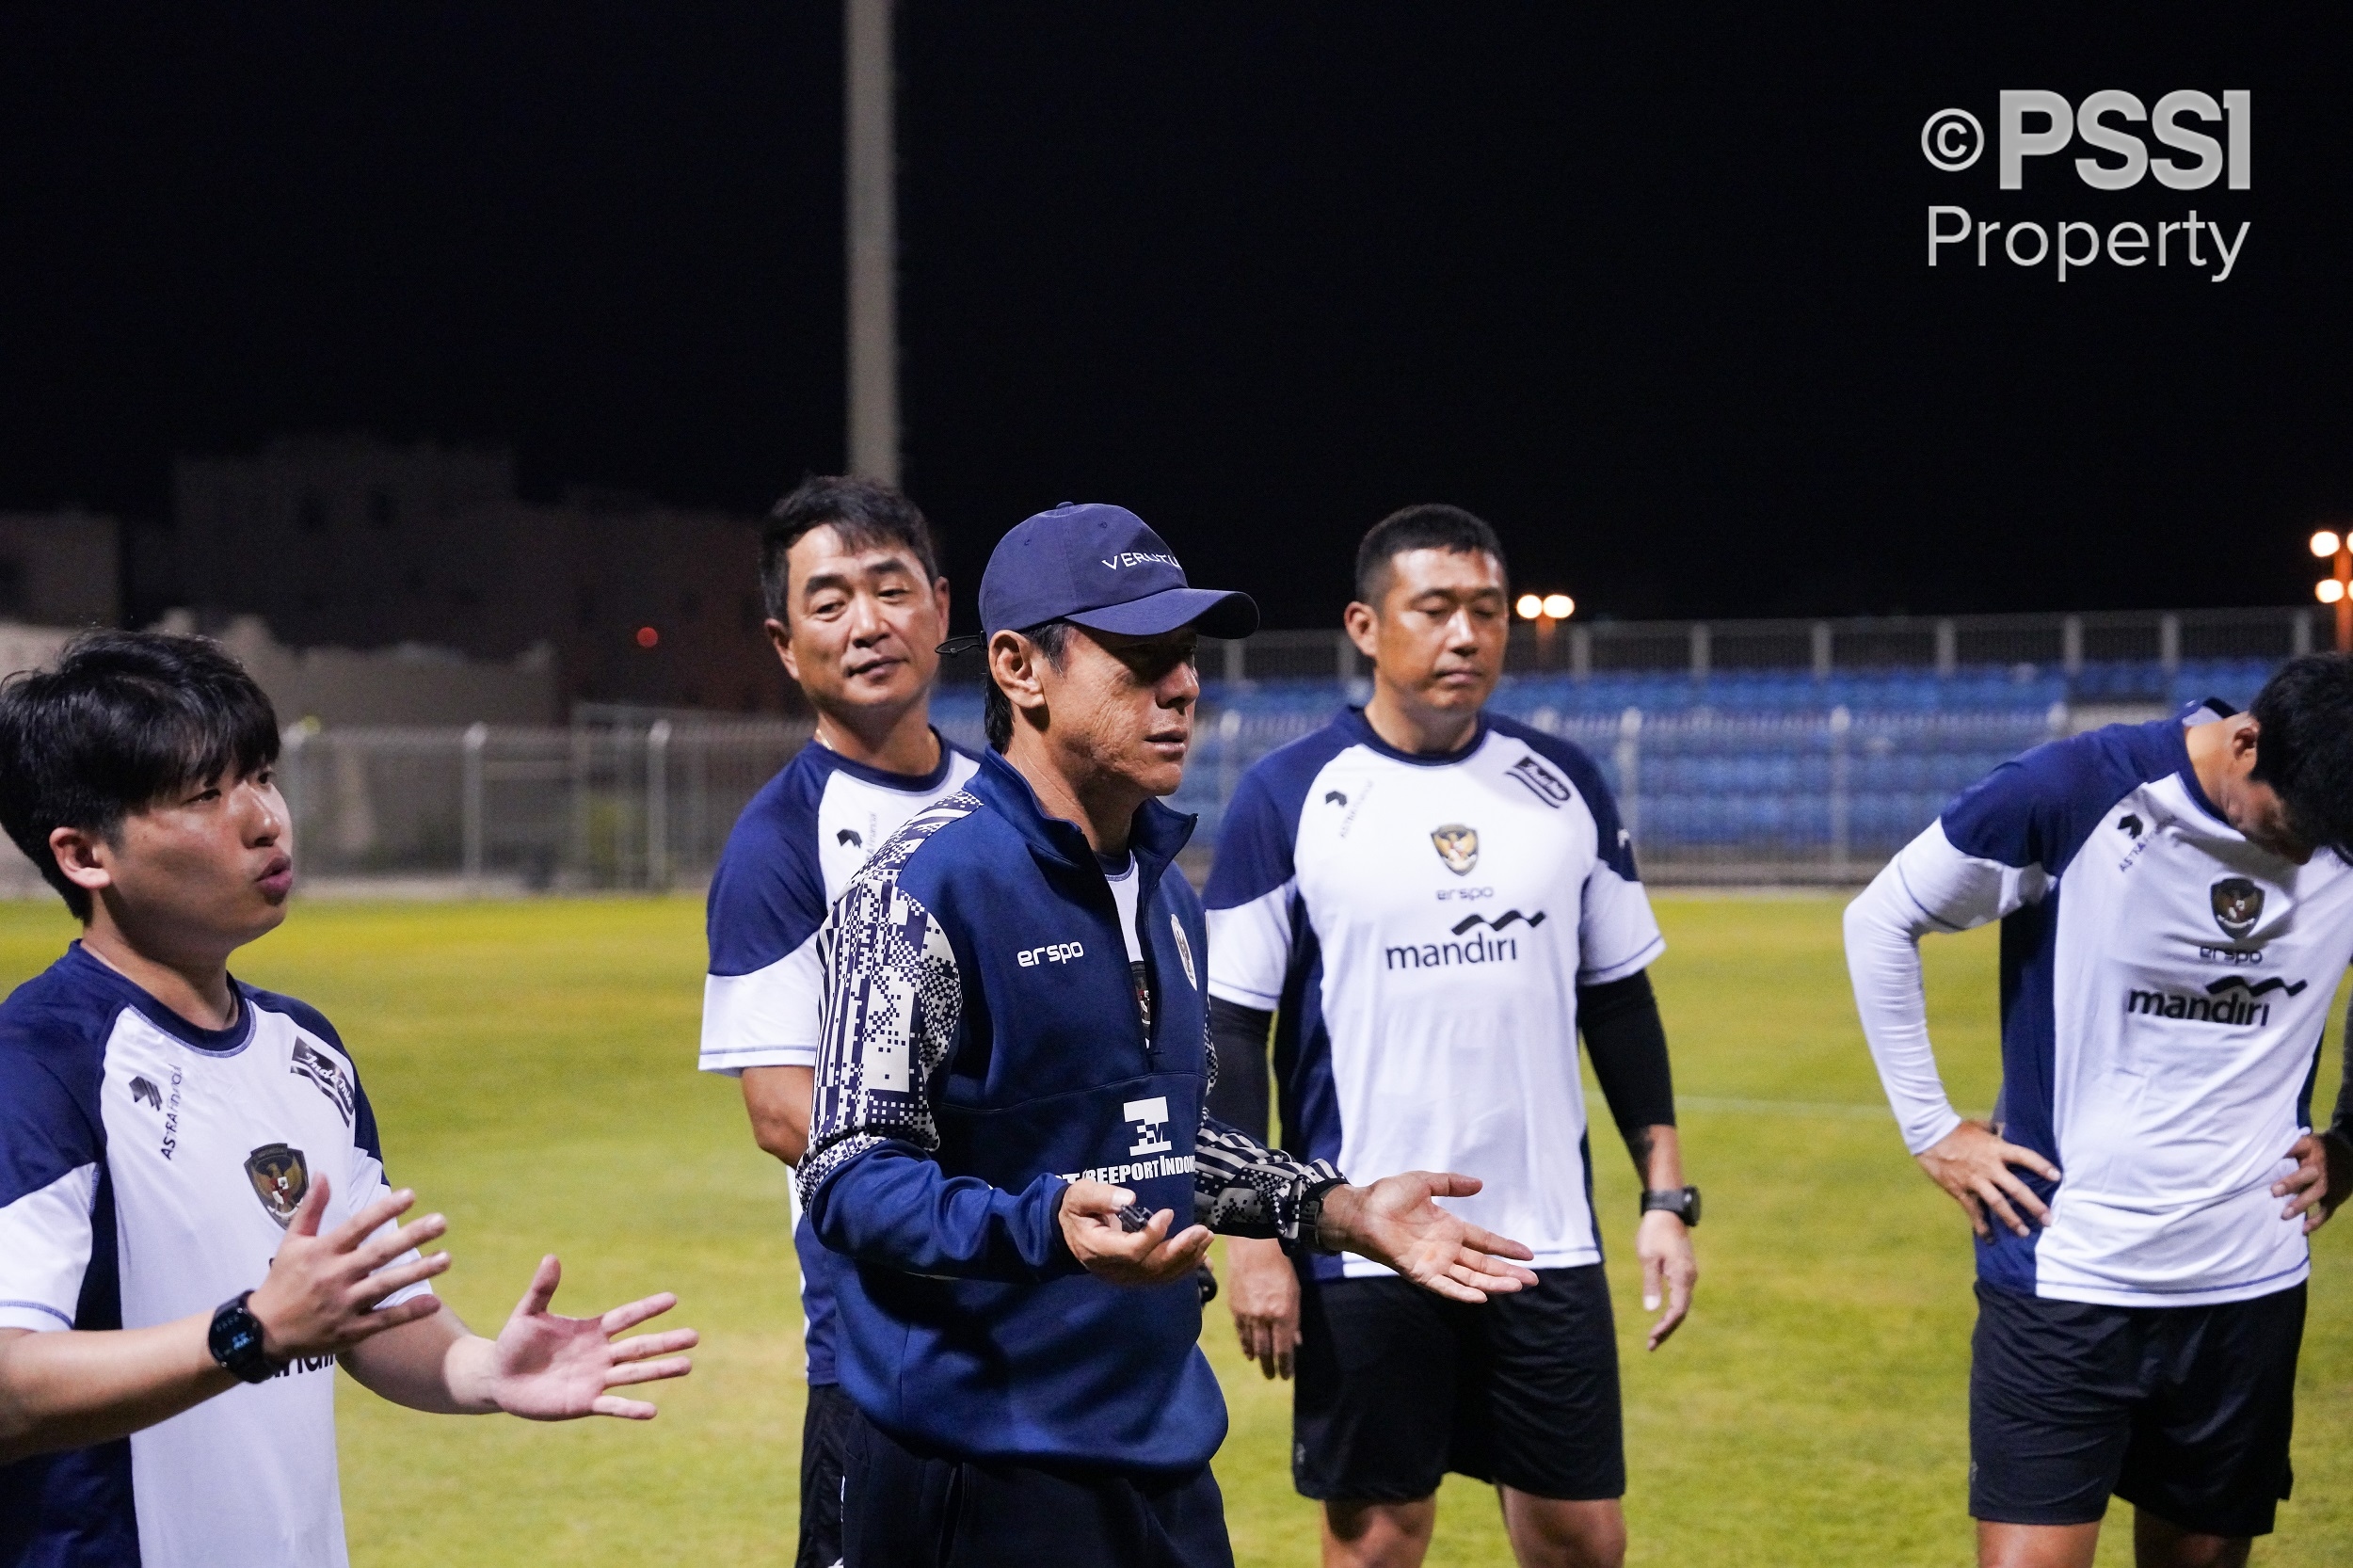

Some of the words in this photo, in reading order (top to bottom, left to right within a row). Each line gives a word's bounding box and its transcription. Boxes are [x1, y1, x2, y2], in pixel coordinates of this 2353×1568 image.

[1436, 886, 1494, 901] erspo
[1016, 941, 1084, 968] erspo
[1385, 932, 1516, 969] mandiri
[2200, 946, 2263, 965] erspo
[2127, 988, 2270, 1027] mandiri
